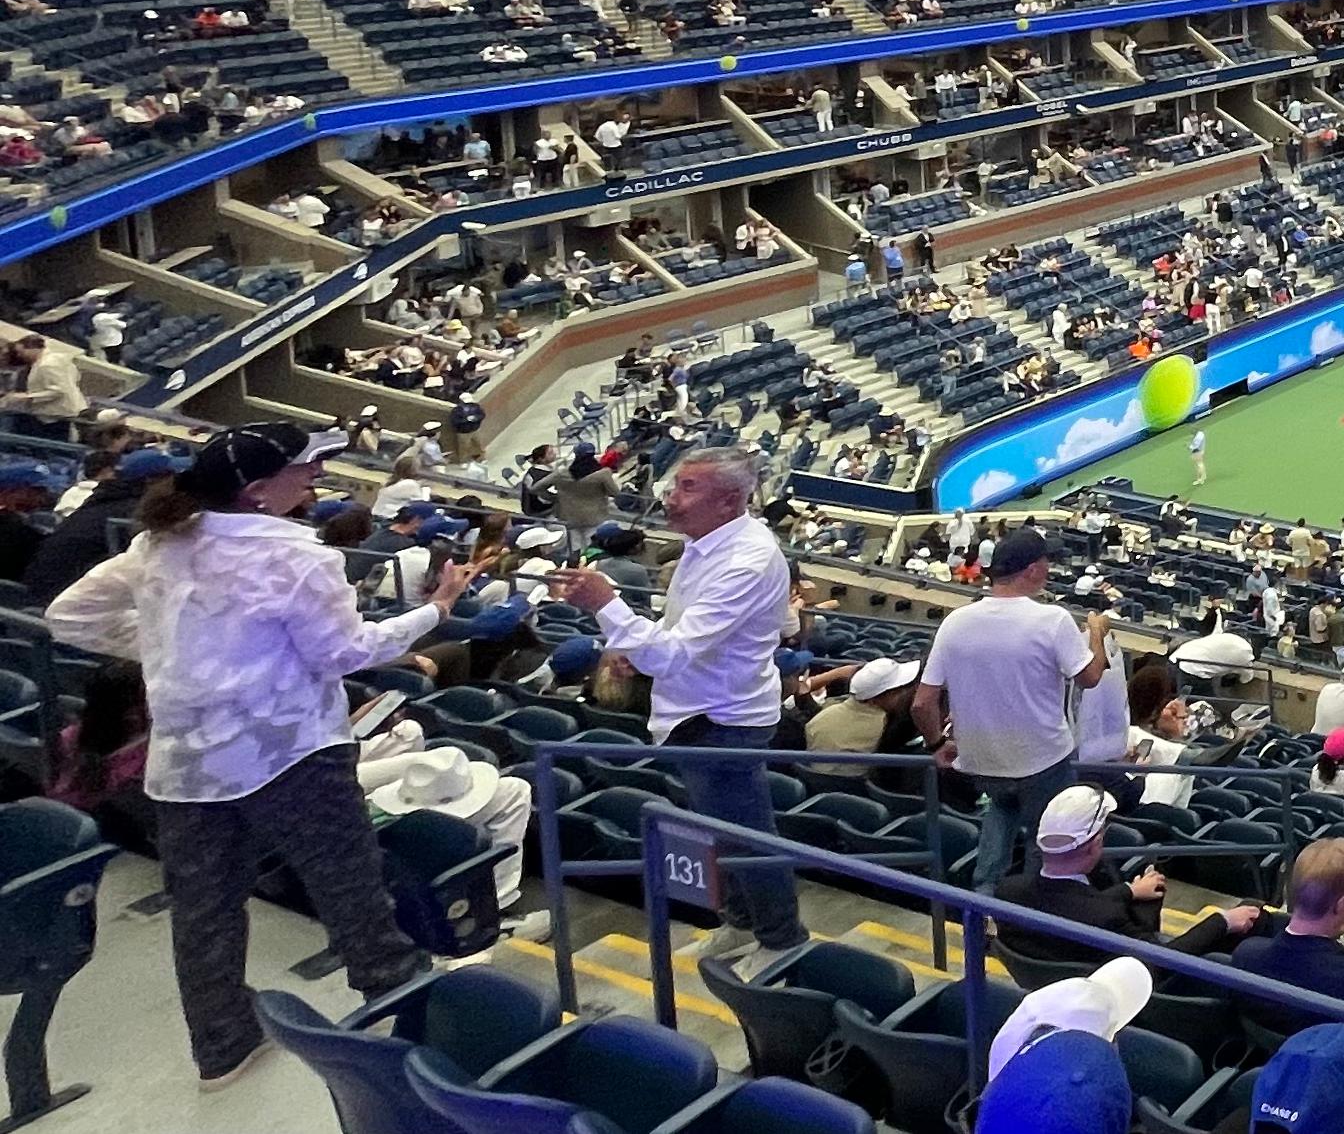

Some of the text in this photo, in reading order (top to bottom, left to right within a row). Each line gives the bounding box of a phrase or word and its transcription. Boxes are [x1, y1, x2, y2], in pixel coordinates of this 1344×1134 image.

[856, 133, 912, 150] CHUBB
[605, 171, 704, 198] CADILLAC
[665, 853, 707, 889] 131
